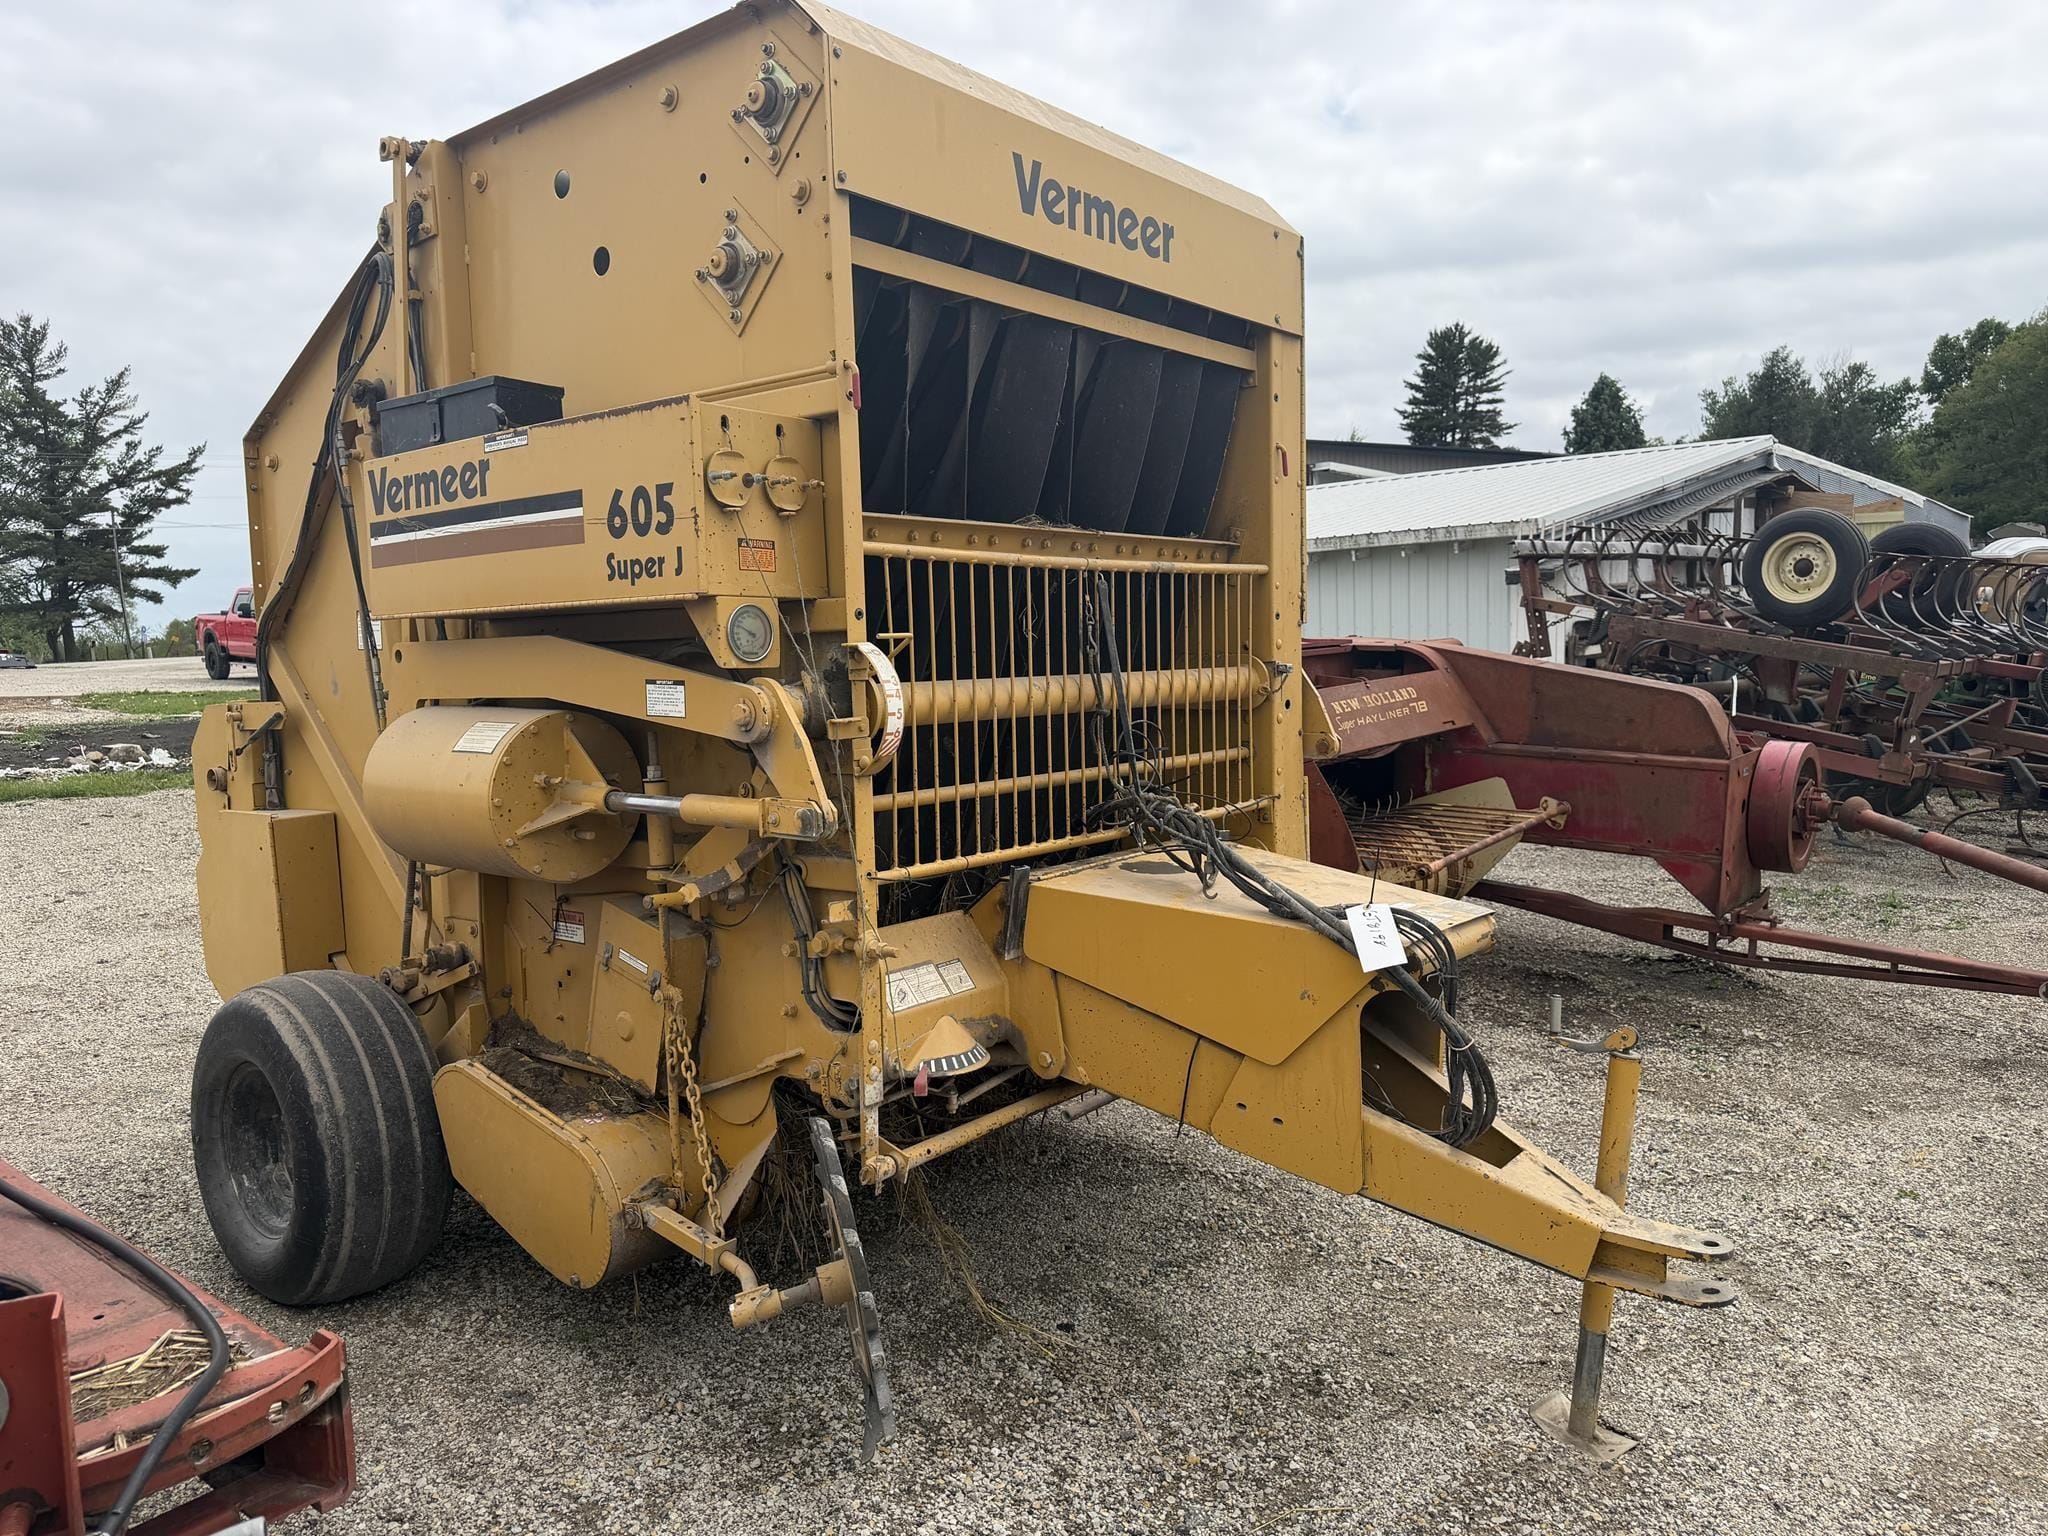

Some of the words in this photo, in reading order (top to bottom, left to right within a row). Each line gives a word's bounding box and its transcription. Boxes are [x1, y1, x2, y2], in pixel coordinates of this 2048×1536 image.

[1012, 152, 1175, 263] Vermeer
[368, 459, 490, 516] Vermeer
[607, 482, 675, 540] 605
[606, 552, 666, 587] Super
[674, 545, 683, 577] J
[891, 675, 899, 687] 3
[894, 688, 901, 701] 4
[896, 707, 903, 720] 5
[1331, 697, 1361, 715] NEW
[1362, 686, 1418, 708] HOLLAND
[893, 727, 901, 739] 6
[1335, 716, 1356, 736] Super
[1356, 706, 1411, 727] HAYLINER
[1409, 700, 1429, 714] 78
